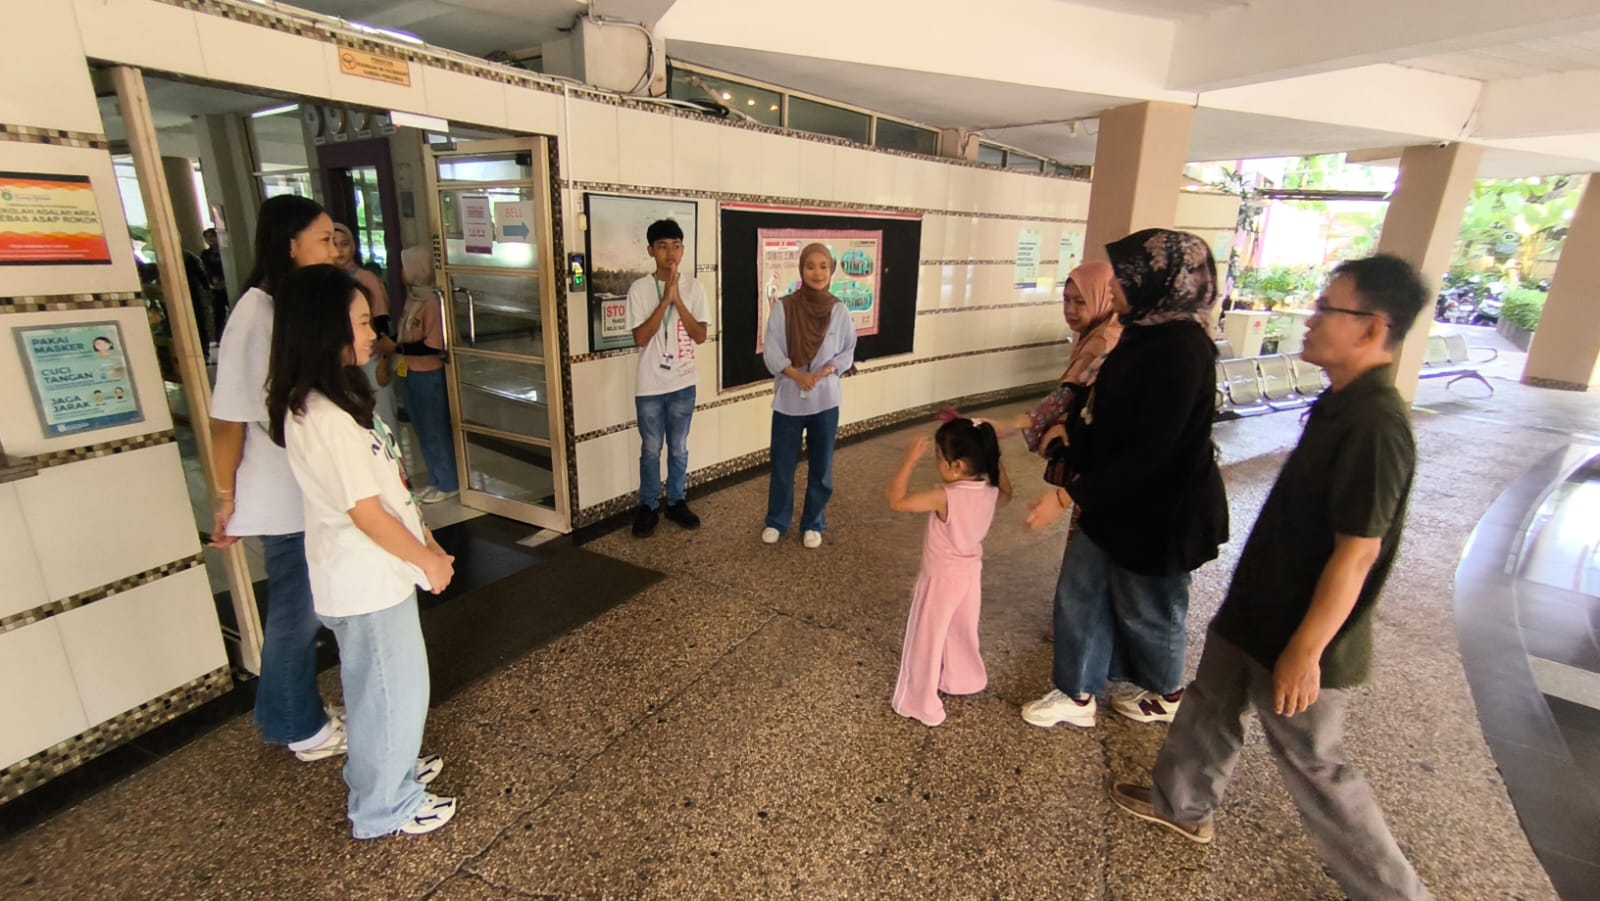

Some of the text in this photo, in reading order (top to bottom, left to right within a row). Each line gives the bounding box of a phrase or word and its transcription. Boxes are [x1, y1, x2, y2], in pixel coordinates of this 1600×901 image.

[31, 215, 60, 223] ASAP
[62, 216, 99, 224] ROKOK
[607, 304, 625, 318] STO
[32, 336, 70, 346] PAKAI
[34, 343, 84, 354] MASKER
[41, 366, 71, 377] CUCI
[44, 372, 94, 383] TANGAN
[50, 395, 82, 405] JAGA
[53, 401, 90, 413] JARAK
